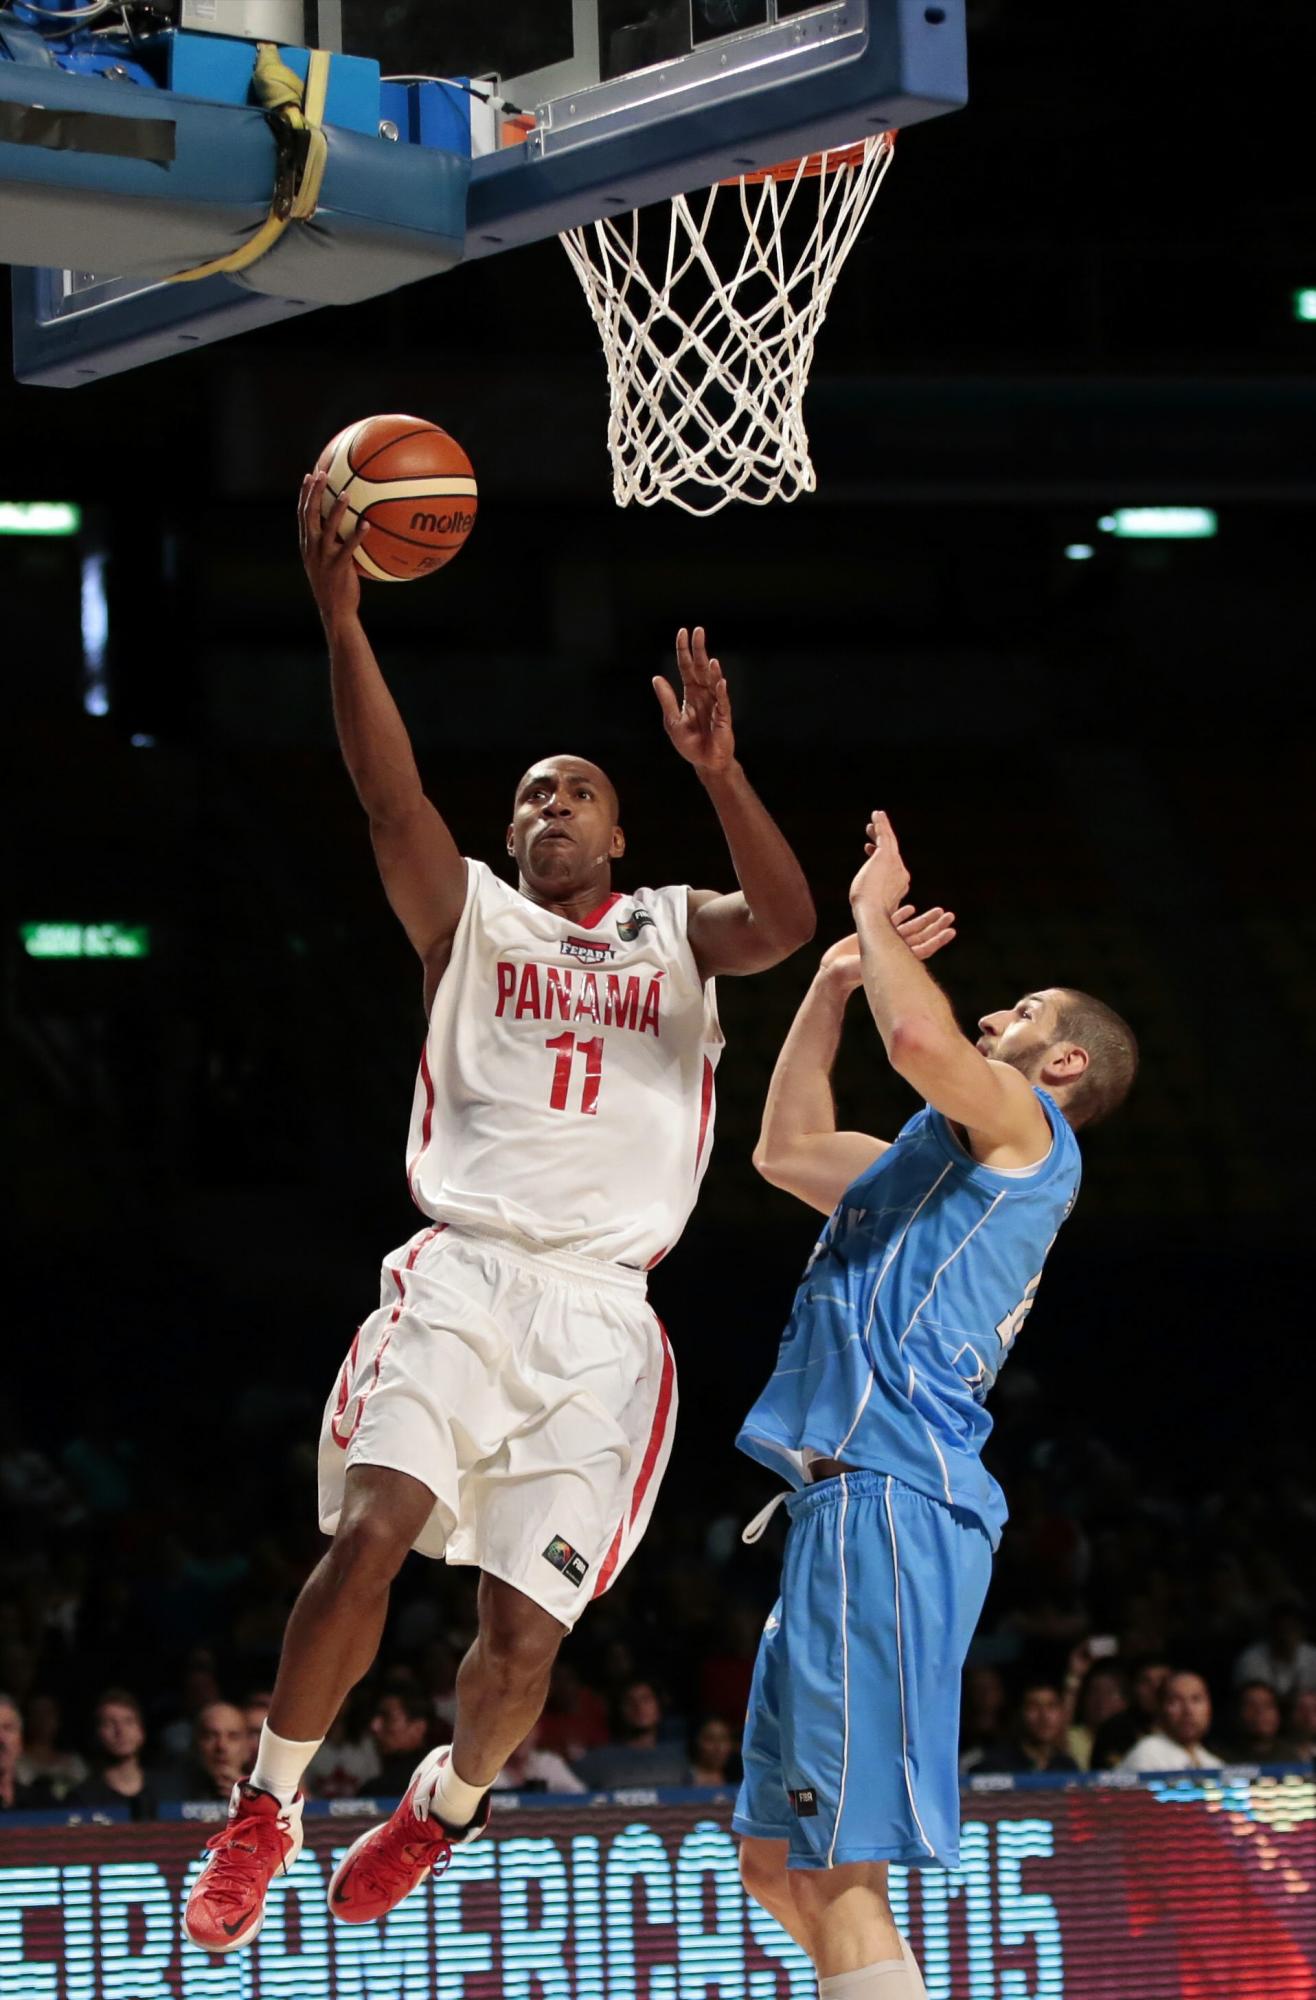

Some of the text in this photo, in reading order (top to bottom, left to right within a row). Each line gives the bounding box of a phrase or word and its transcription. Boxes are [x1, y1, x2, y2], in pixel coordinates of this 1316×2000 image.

[410, 511, 477, 534] molte
[495, 961, 665, 1038] PANAMÁ
[545, 1031, 604, 1115] 11
